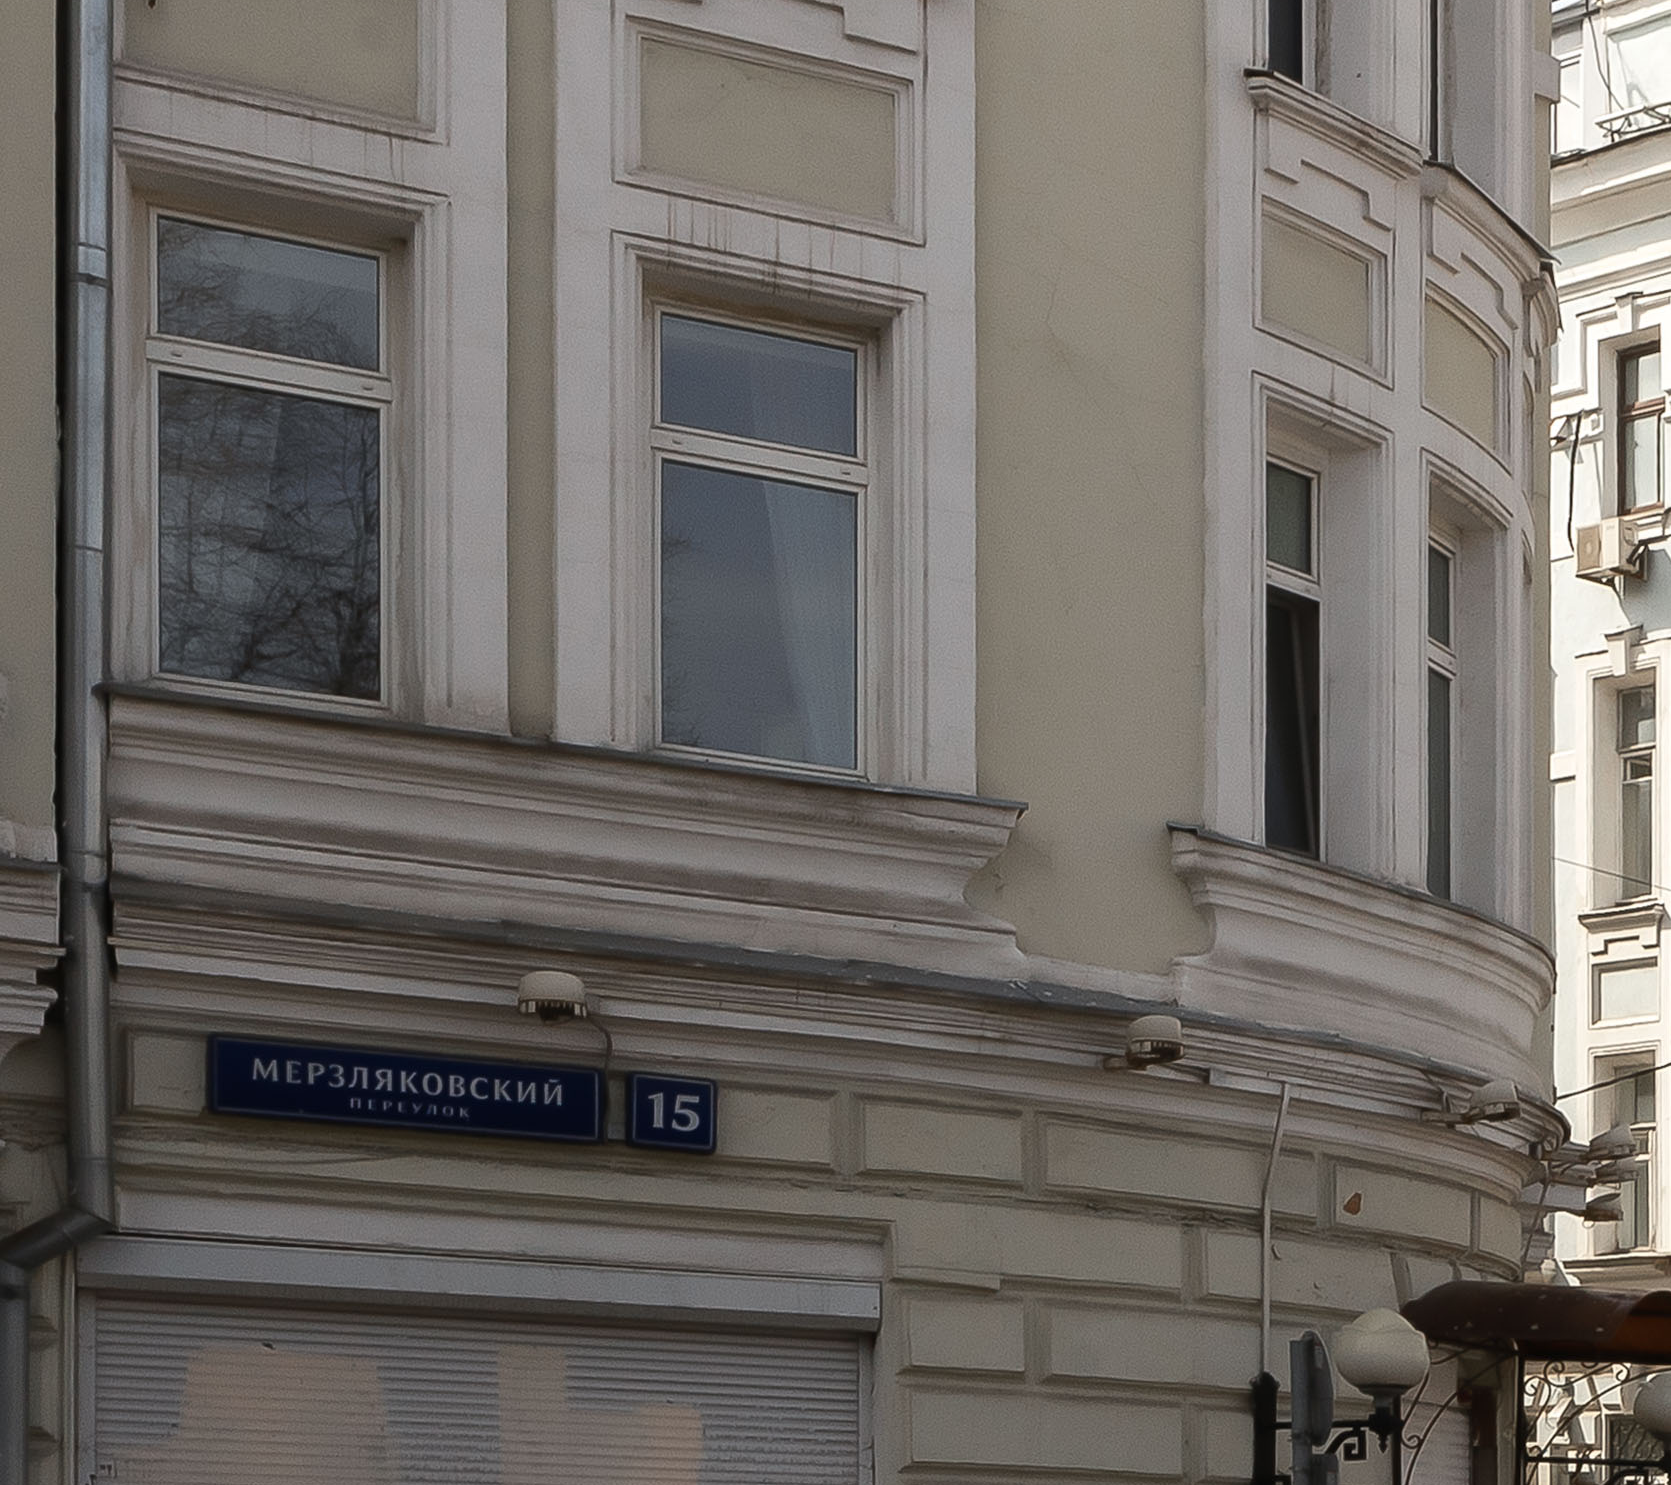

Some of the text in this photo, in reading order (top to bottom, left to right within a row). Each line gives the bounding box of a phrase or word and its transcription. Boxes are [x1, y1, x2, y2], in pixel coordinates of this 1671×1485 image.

[251, 1056, 563, 1107] МЕРЗЛЯКОВСКИЙ
[349, 1096, 470, 1120] ПЕРЕУЛОК
[646, 1091, 702, 1132] 15
